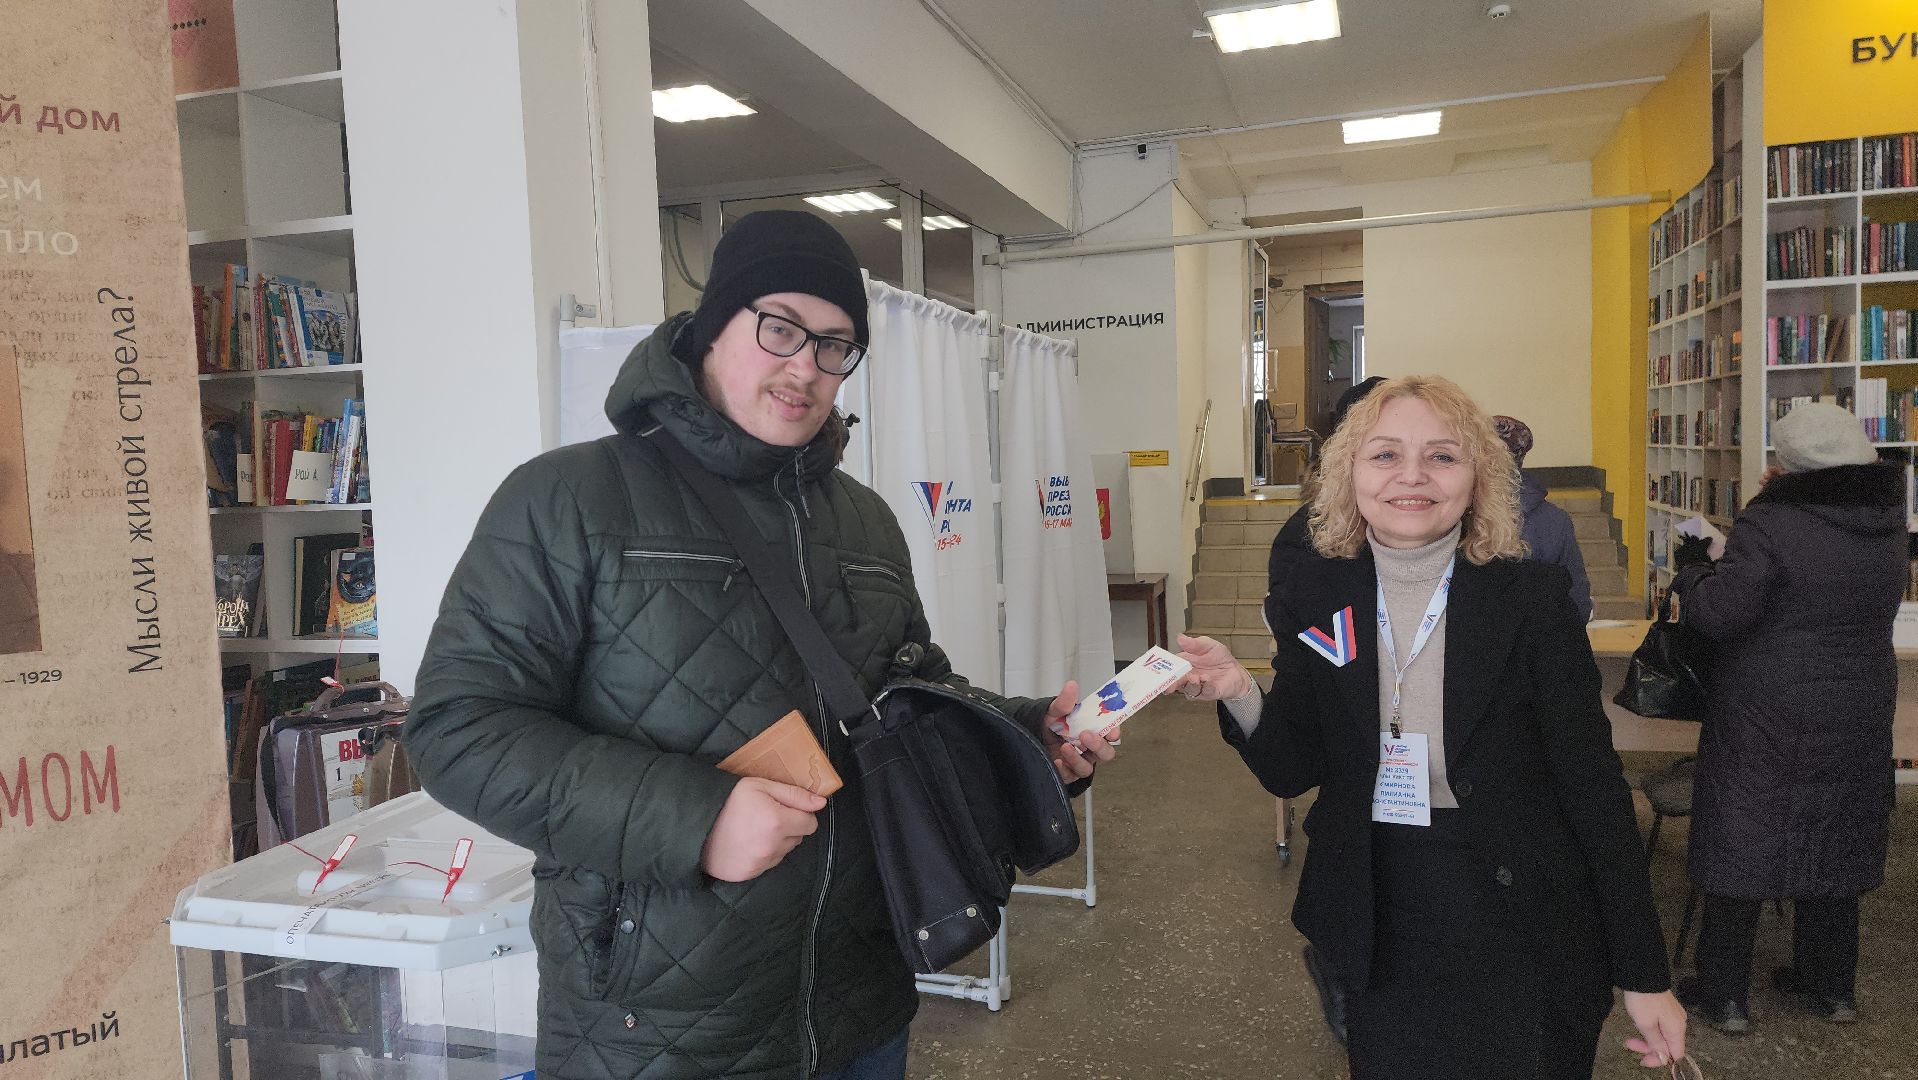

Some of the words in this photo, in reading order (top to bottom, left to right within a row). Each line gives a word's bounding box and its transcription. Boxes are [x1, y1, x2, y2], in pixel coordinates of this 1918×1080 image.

[97, 287, 152, 422] стрела?
[116, 435, 153, 543] живой
[126, 556, 163, 674] Мысли
[0, 1010, 120, 1065] латый
